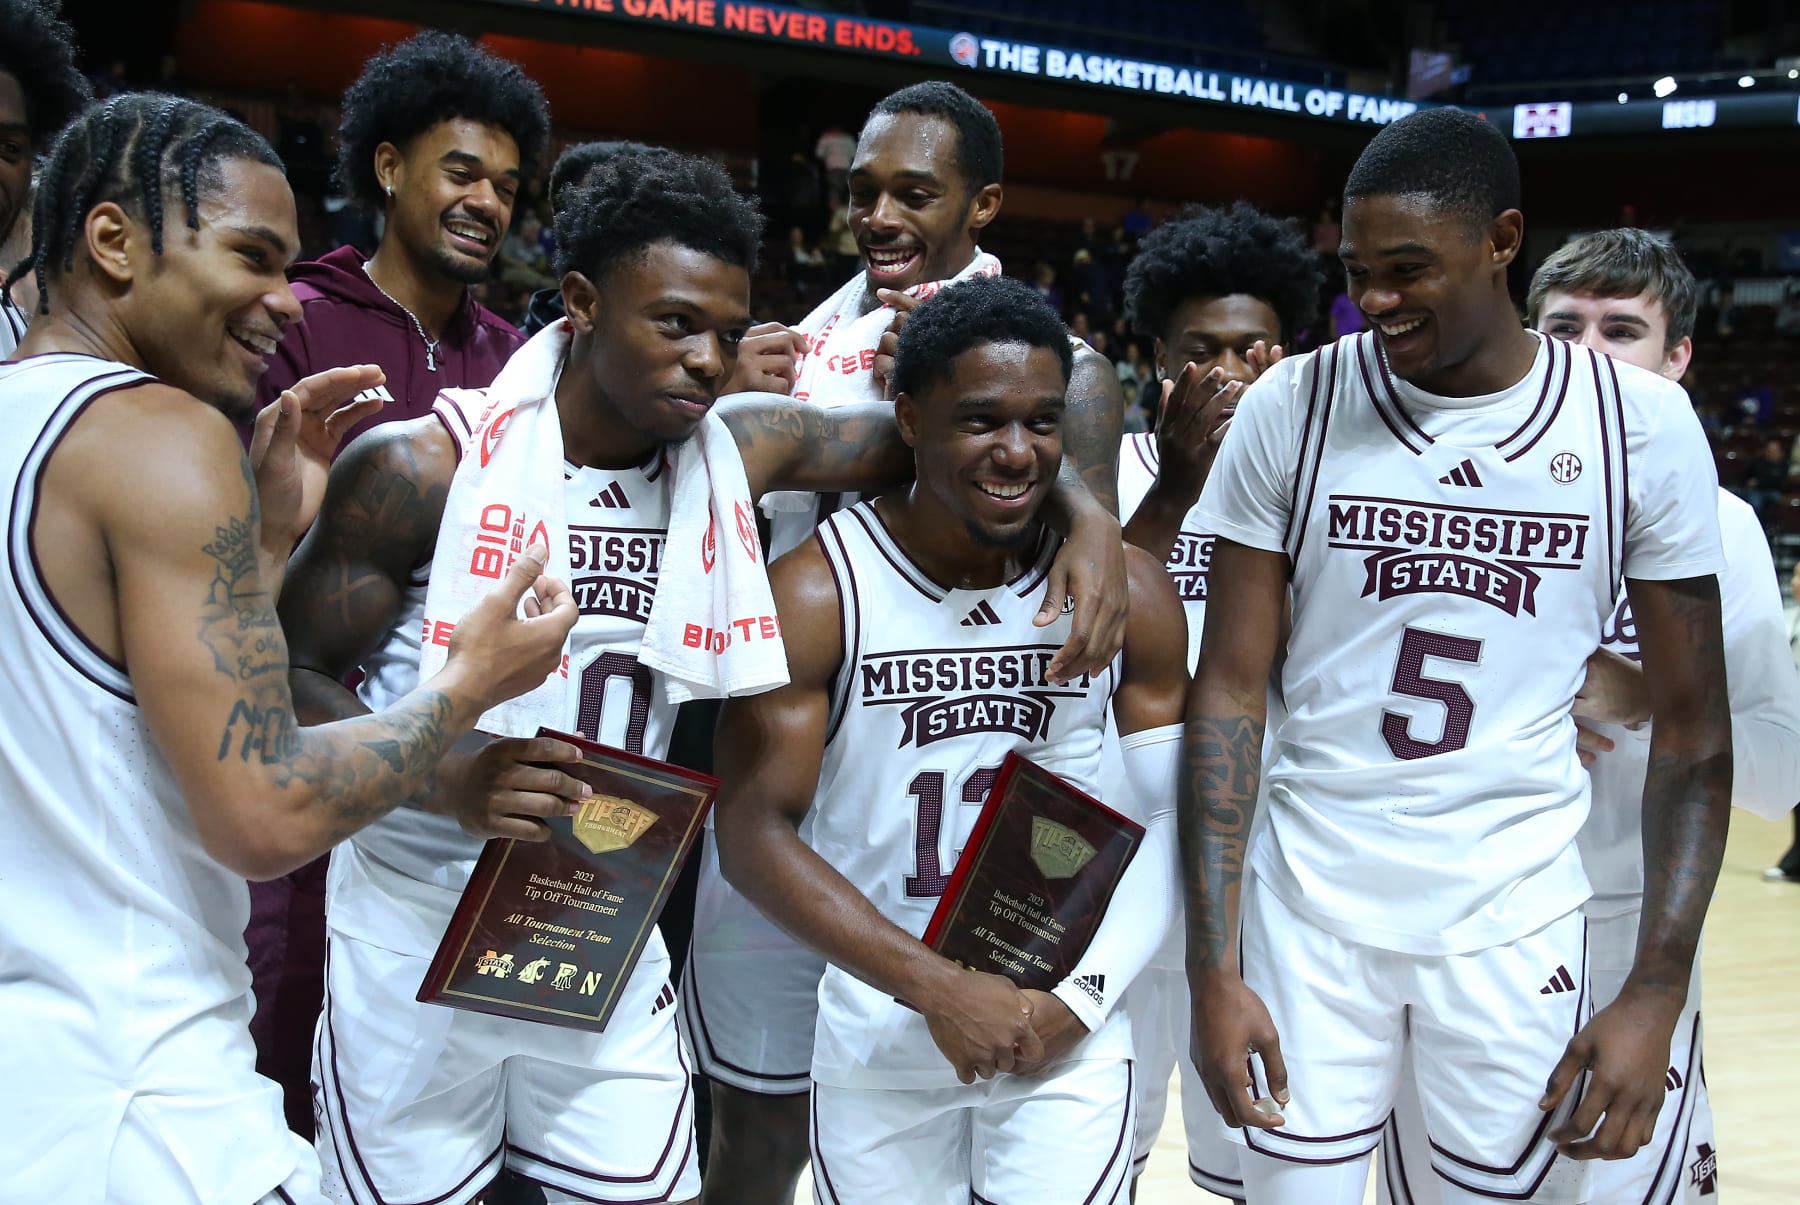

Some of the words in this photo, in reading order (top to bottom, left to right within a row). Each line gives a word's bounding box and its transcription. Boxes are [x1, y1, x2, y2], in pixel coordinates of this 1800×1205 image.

[622, 0, 716, 27] GAME
[723, 3, 827, 43] NEVER
[834, 19, 921, 56] ENDS.
[981, 40, 1040, 74] THE
[1046, 49, 1225, 101] BASKETBALL
[1230, 76, 1300, 113] HALL
[1306, 88, 1344, 118] OF
[1550, 453, 1582, 483] SEC
[470, 504, 512, 580] BIO
[505, 512, 527, 577] TEEL
[1328, 504, 1589, 560] MISSISSIPPI
[574, 582, 655, 619] TATE
[1391, 559, 1510, 604] STATE
[860, 652, 1091, 698] MISSISSIP
[1380, 624, 1485, 762] 5
[928, 699, 1033, 736] STATE
[902, 766, 1003, 900] 1
[529, 873, 573, 892] Basketball
[573, 883, 592, 896] Hall
[591, 889, 602, 898] of
[602, 890, 625, 904] Fame
[573, 870, 595, 883] 2023
[524, 885, 541, 901] Tip
[543, 890, 563, 903] Off
[562, 894, 619, 917] Tournament
[993, 889, 1027, 914] Basketball
[1026, 906, 1042, 921] Hall
[1041, 914, 1051, 925] of
[1048, 918, 1066, 934] Fame
[1027, 892, 1045, 907] 2023
[504, 913, 524, 925] All
[523, 916, 585, 939] Tournament
[584, 930, 612, 945] Team
[529, 933, 577, 952] Selection
[989, 900, 1002, 917] Tip
[1003, 908, 1019, 923] Off
[1018, 914, 1061, 945] Tournament
[971, 926, 987, 939] All
[985, 931, 1034, 963] Tournament
[1032, 955, 1054, 973] Team
[989, 949, 1026, 974] Selection
[579, 971, 602, 996] N
[1073, 977, 1104, 1005] adidas
